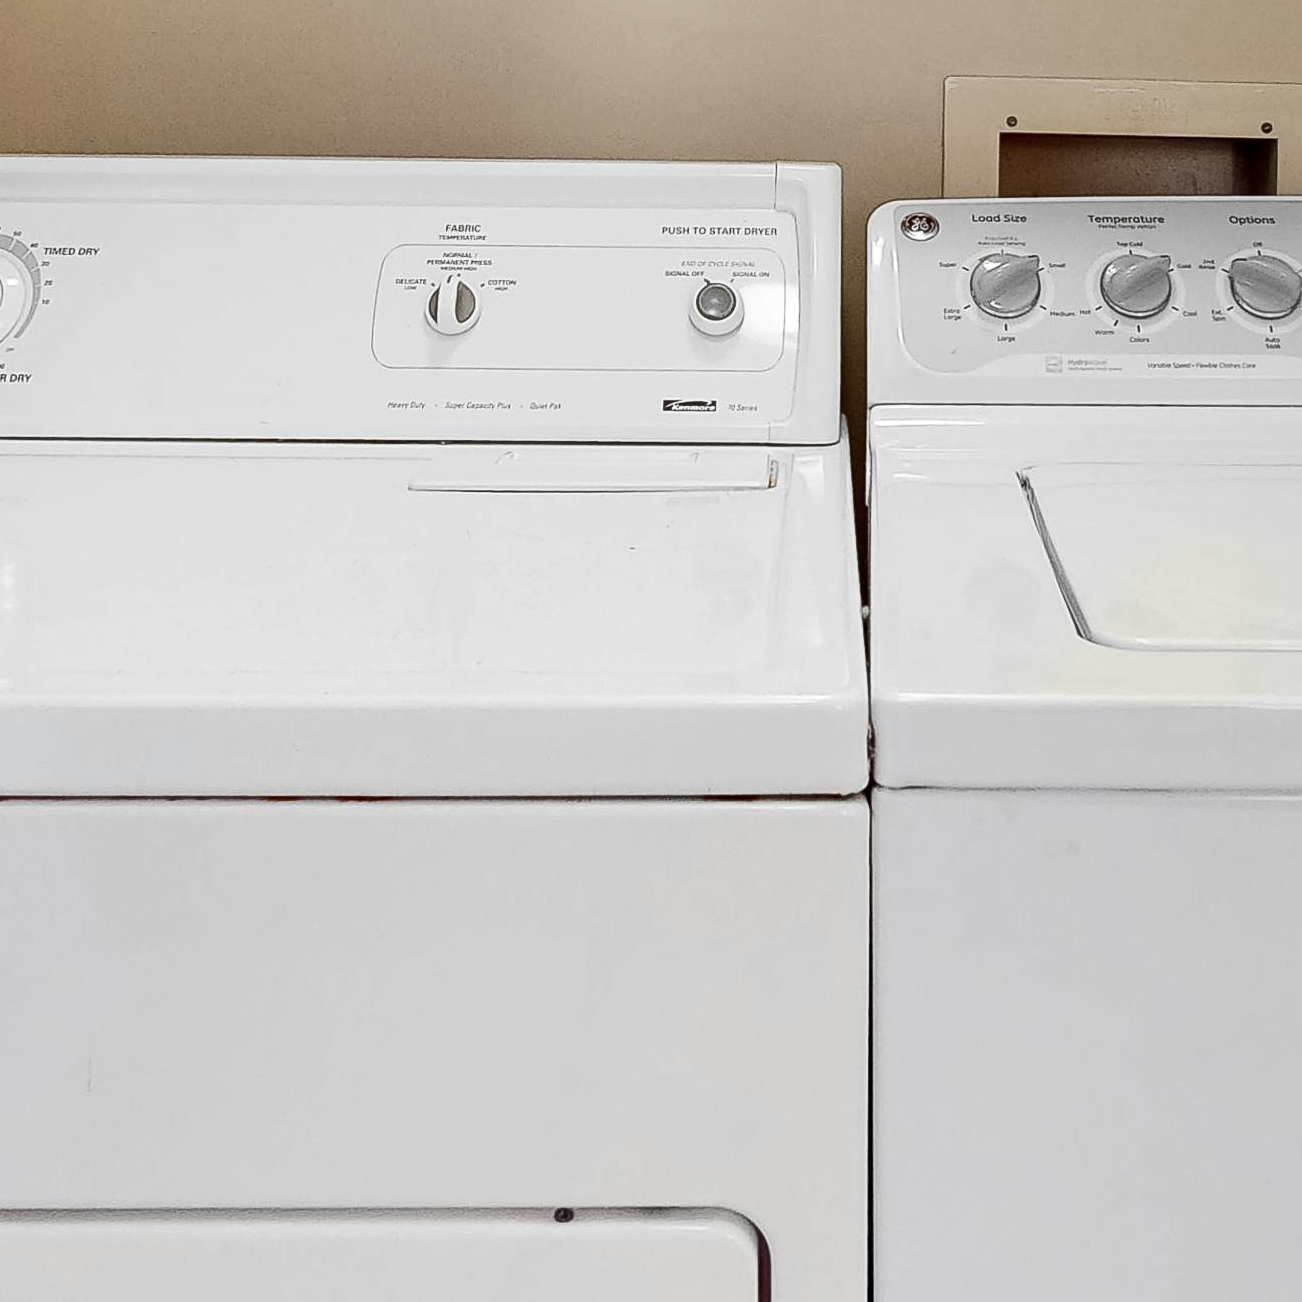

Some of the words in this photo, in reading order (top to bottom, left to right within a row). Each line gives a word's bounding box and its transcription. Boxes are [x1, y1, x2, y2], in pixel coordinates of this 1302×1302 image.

[972, 213, 1000, 223] Load
[1004, 213, 1027, 223] Size
[1087, 215, 1165, 225] Temperature
[1229, 215, 1276, 226] Options
[445, 224, 482, 233] FABRIC
[661, 226, 690, 236] PUSH
[692, 226, 707, 235] TO
[709, 226, 741, 236] START
[744, 227, 778, 236] DRYER
[43, 247, 76, 256] TIMED
[78, 247, 100, 256] DRY
[395, 278, 427, 286] DELICATE
[997, 335, 1016, 343] Large
[9, 373, 32, 383] DRY
[387, 401, 409, 410] Heavy
[409, 401, 426, 410] Duty
[671, 403, 717, 411] Kenmore
